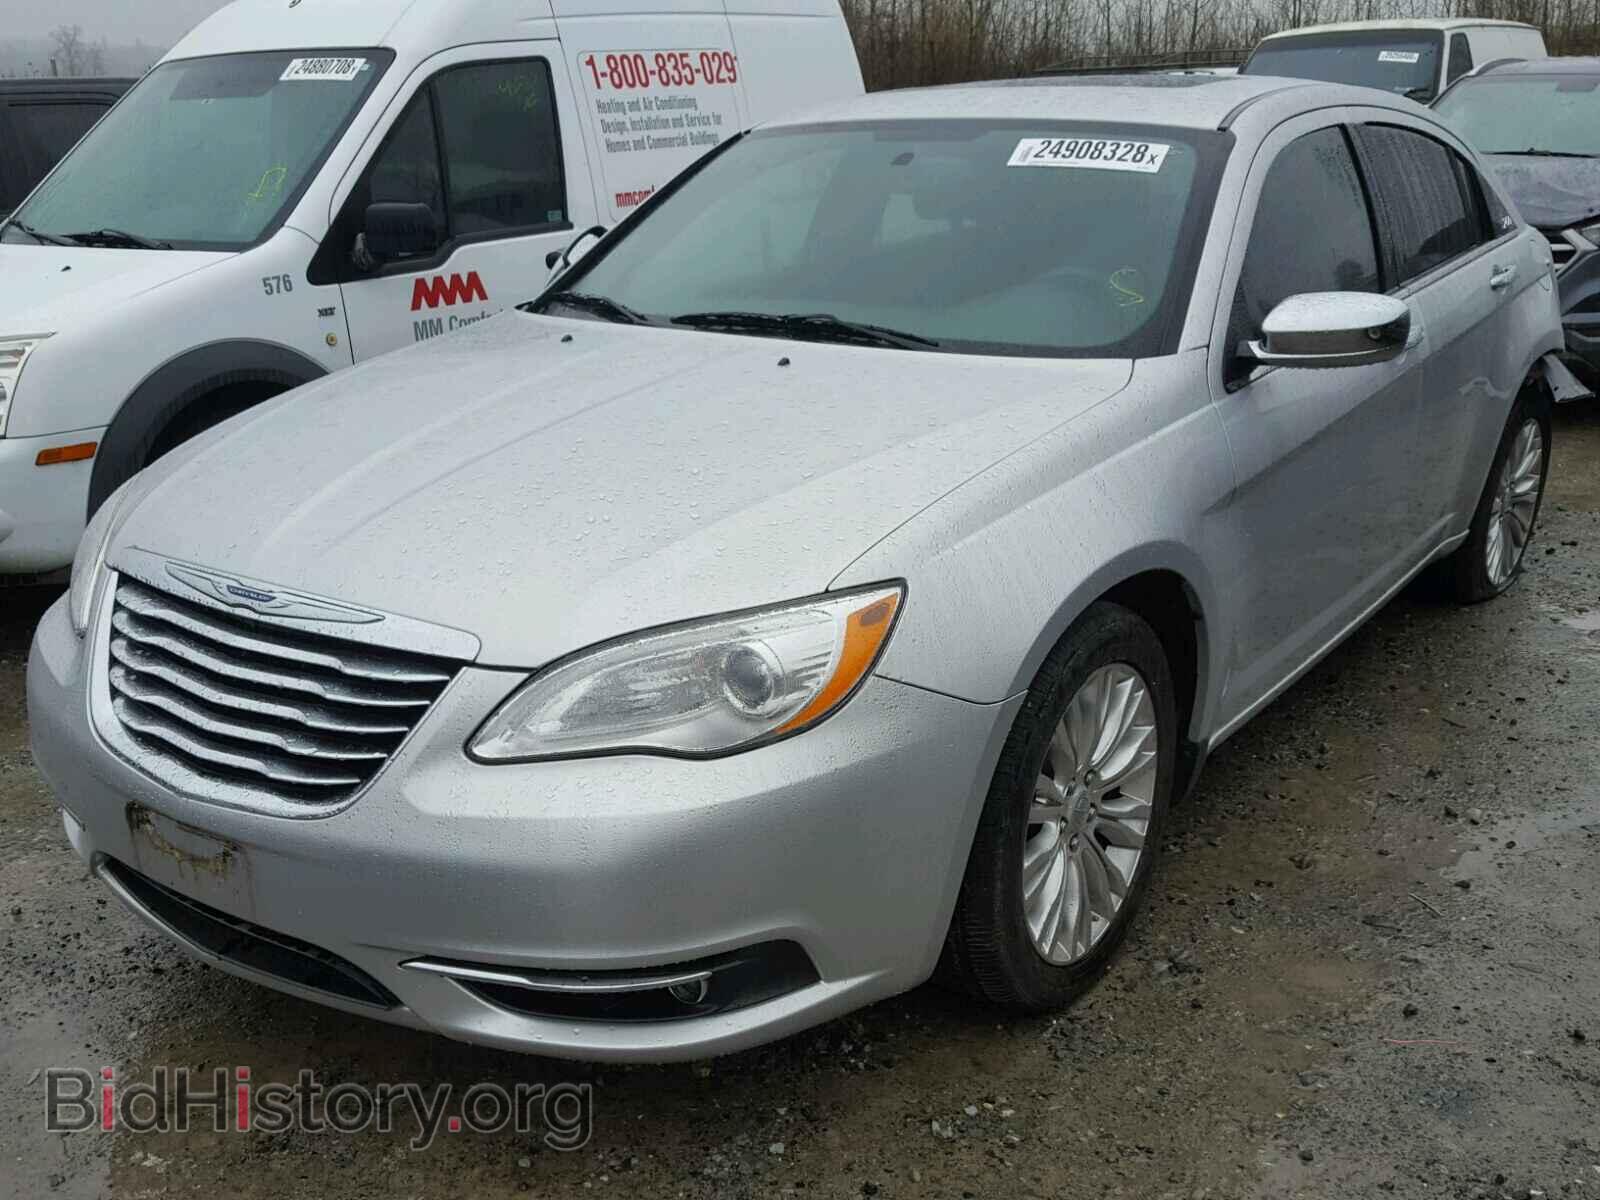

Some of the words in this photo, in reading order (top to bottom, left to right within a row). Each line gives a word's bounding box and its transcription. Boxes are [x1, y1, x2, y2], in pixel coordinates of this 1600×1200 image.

[585, 51, 737, 90] 1-800-835-029
[596, 98, 627, 115] Heating
[628, 98, 641, 112] and
[643, 97, 653, 111] Air
[655, 95, 698, 111] Conditioning
[630, 115, 671, 131] Installation
[671, 115, 684, 128] and
[686, 113, 712, 127] Service
[712, 112, 722, 126] for
[605, 138, 631, 153] Homes
[633, 136, 646, 151] and
[647, 133, 688, 150] Commercial
[689, 131, 719, 147] Buildings
[262, 273, 293, 296] 576
[413, 317, 444, 342] MM
